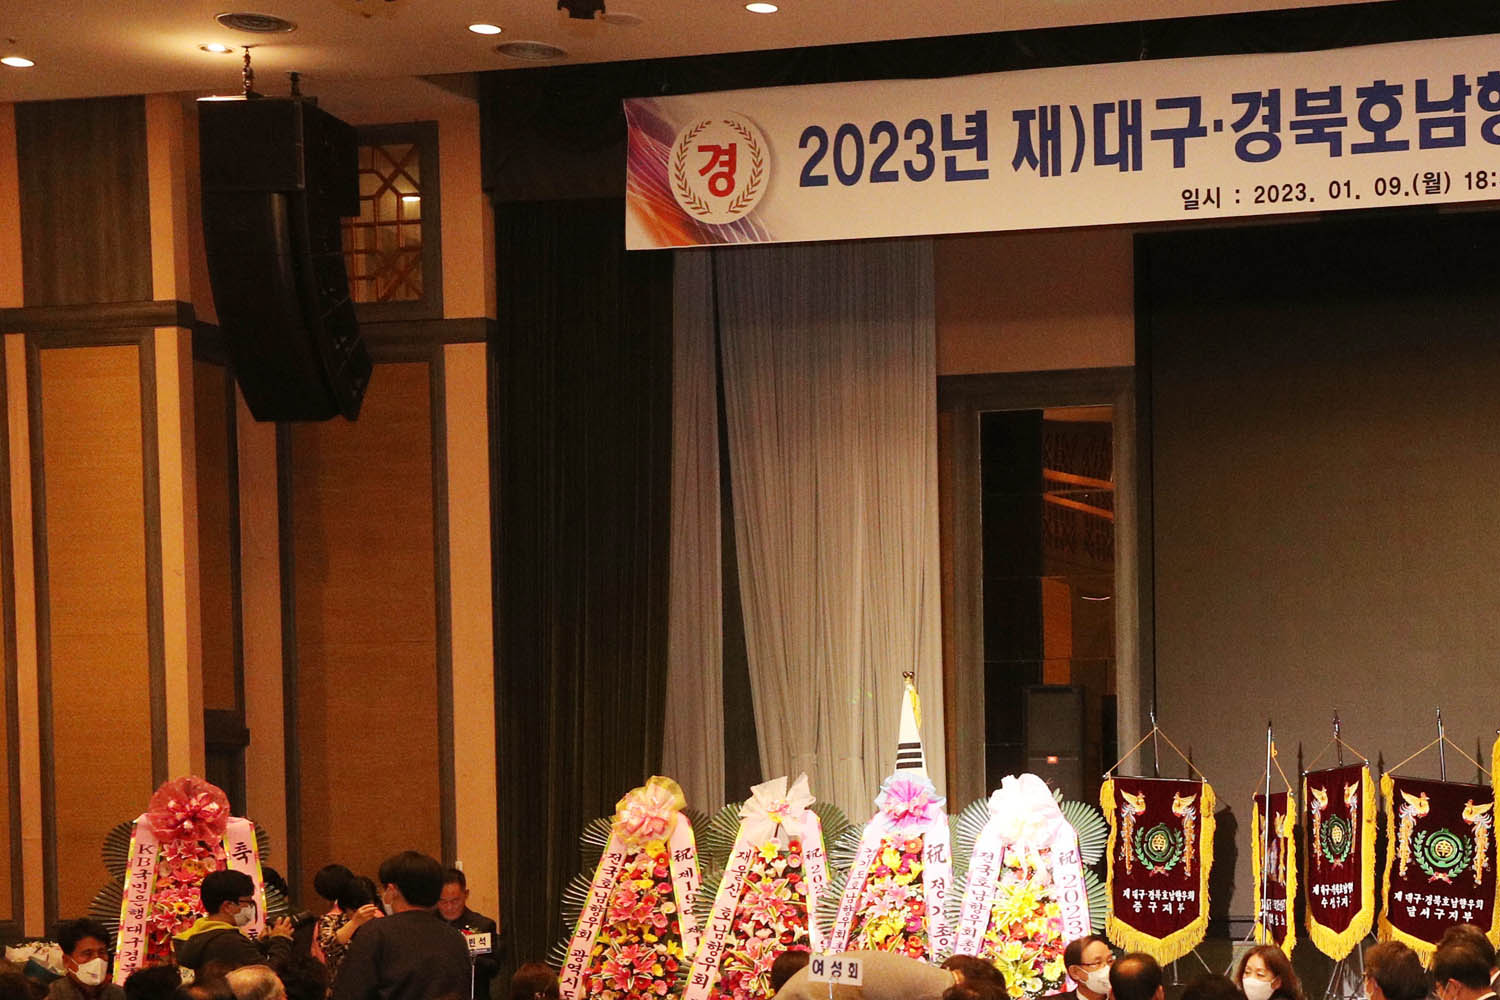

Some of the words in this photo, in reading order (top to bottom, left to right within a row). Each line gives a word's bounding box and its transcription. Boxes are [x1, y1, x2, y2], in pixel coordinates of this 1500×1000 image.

[696, 142, 738, 199] 경
[799, 114, 991, 188] 2023년
[1181, 186, 1223, 211] 일시
[1252, 184, 1316, 206] 2023.
[1327, 181, 1364, 203] 01.
[1373, 172, 1453, 200] 09.(월)
[812, 959, 859, 979] 여성회
